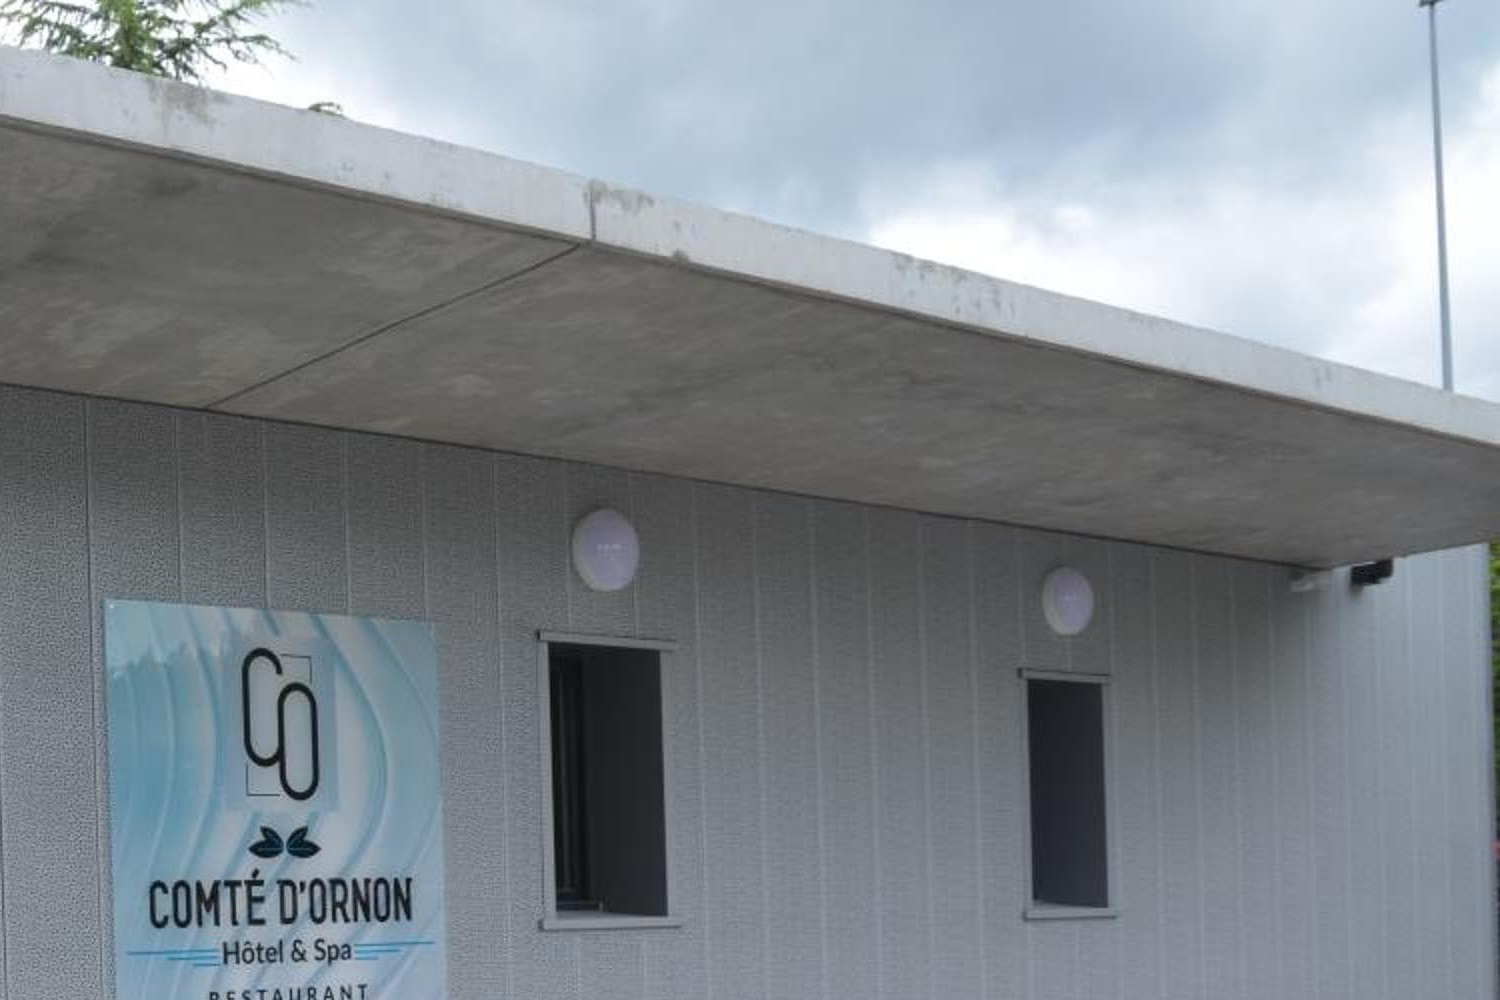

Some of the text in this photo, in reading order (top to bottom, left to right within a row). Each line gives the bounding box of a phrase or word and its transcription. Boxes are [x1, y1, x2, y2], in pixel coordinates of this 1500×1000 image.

[149, 868, 412, 929] COMTÉ D'ORNON
[222, 937, 351, 966] Hôtel & Spa
